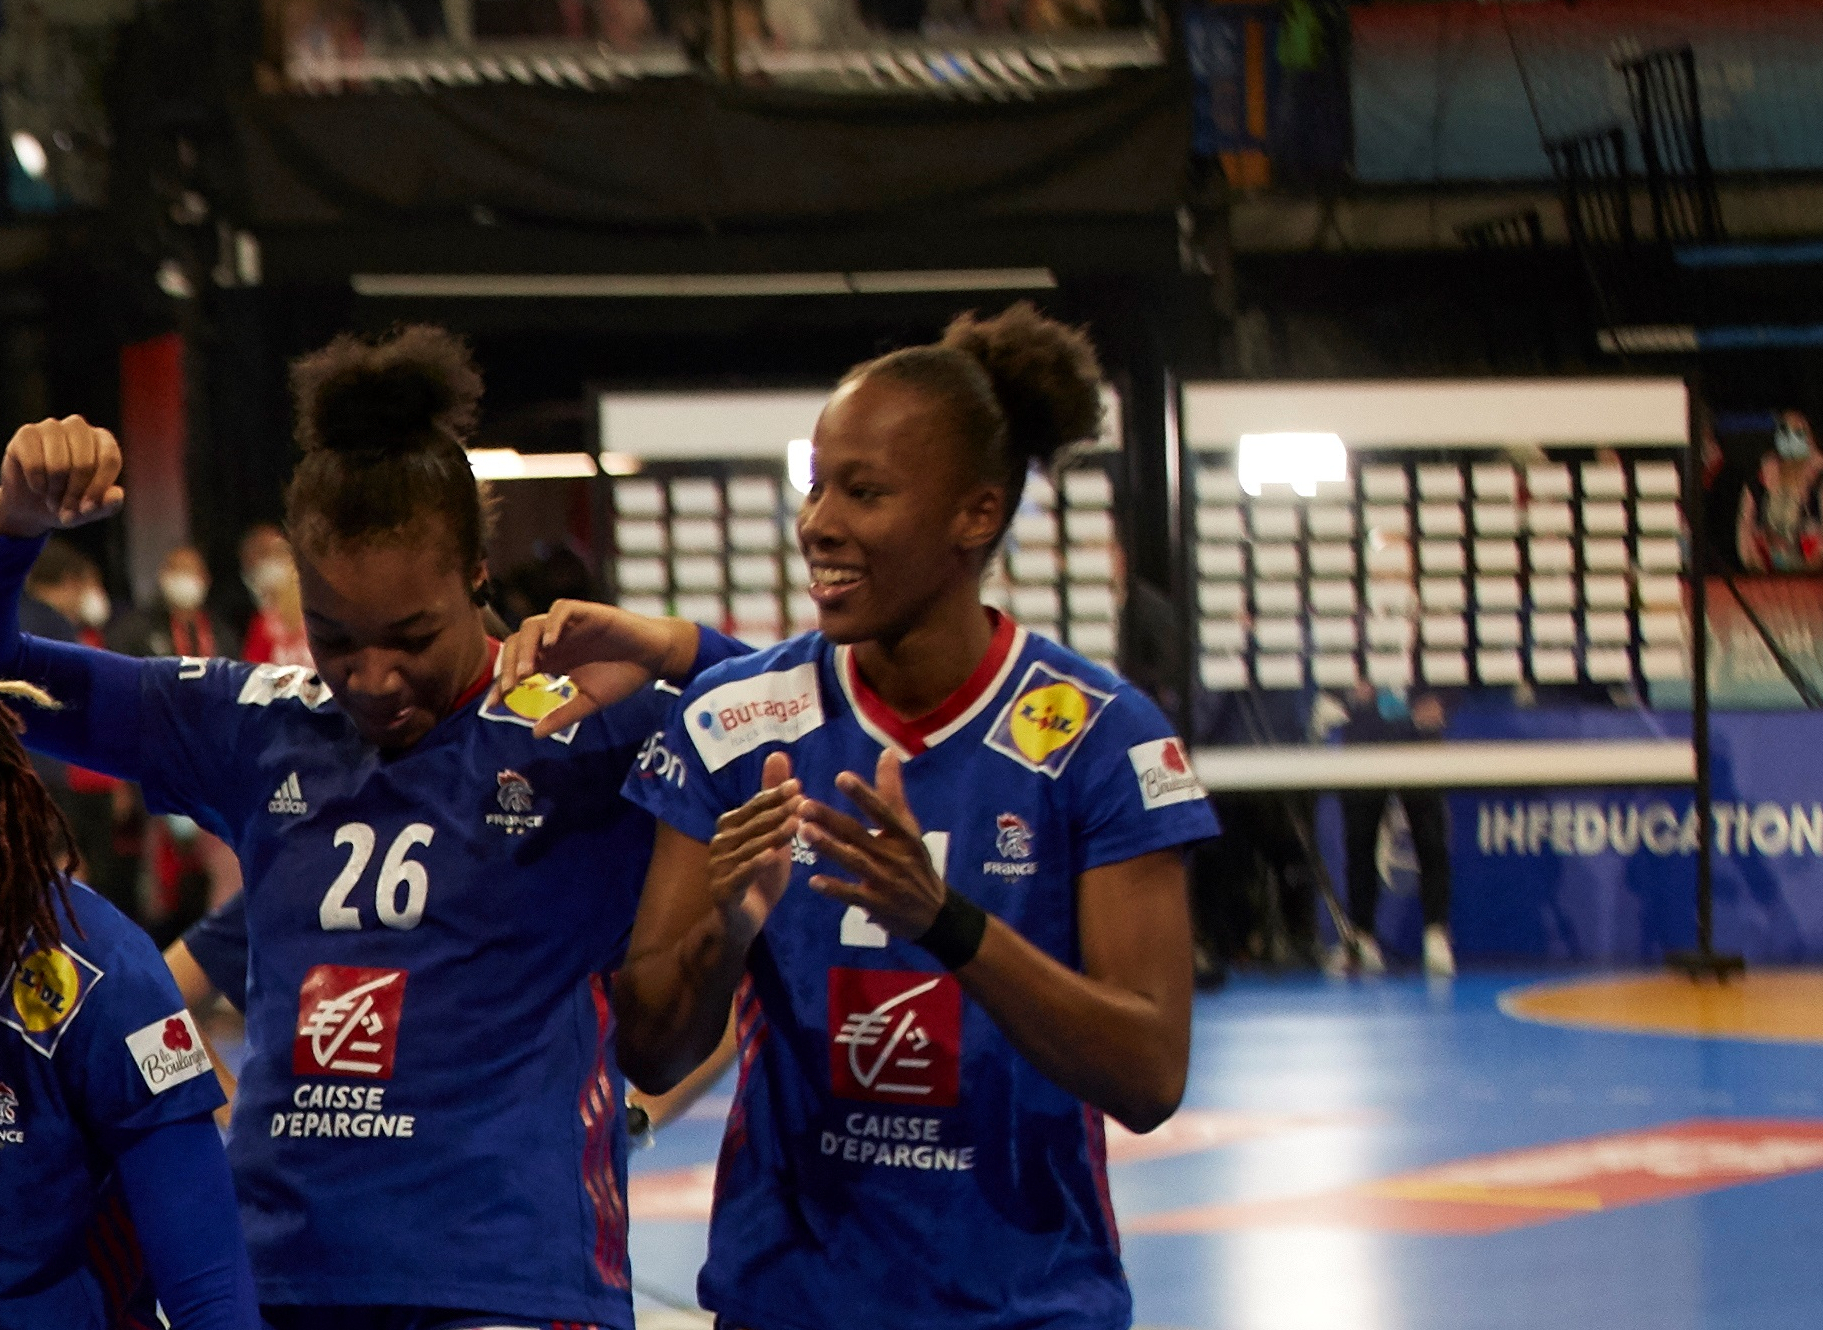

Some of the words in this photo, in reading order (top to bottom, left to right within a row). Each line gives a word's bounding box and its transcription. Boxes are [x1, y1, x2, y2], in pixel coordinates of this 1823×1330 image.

[718, 693, 811, 731] Butagaz
[319, 822, 436, 931] 26
[293, 1084, 385, 1110] CAISSE
[846, 1112, 942, 1142] CAISSE
